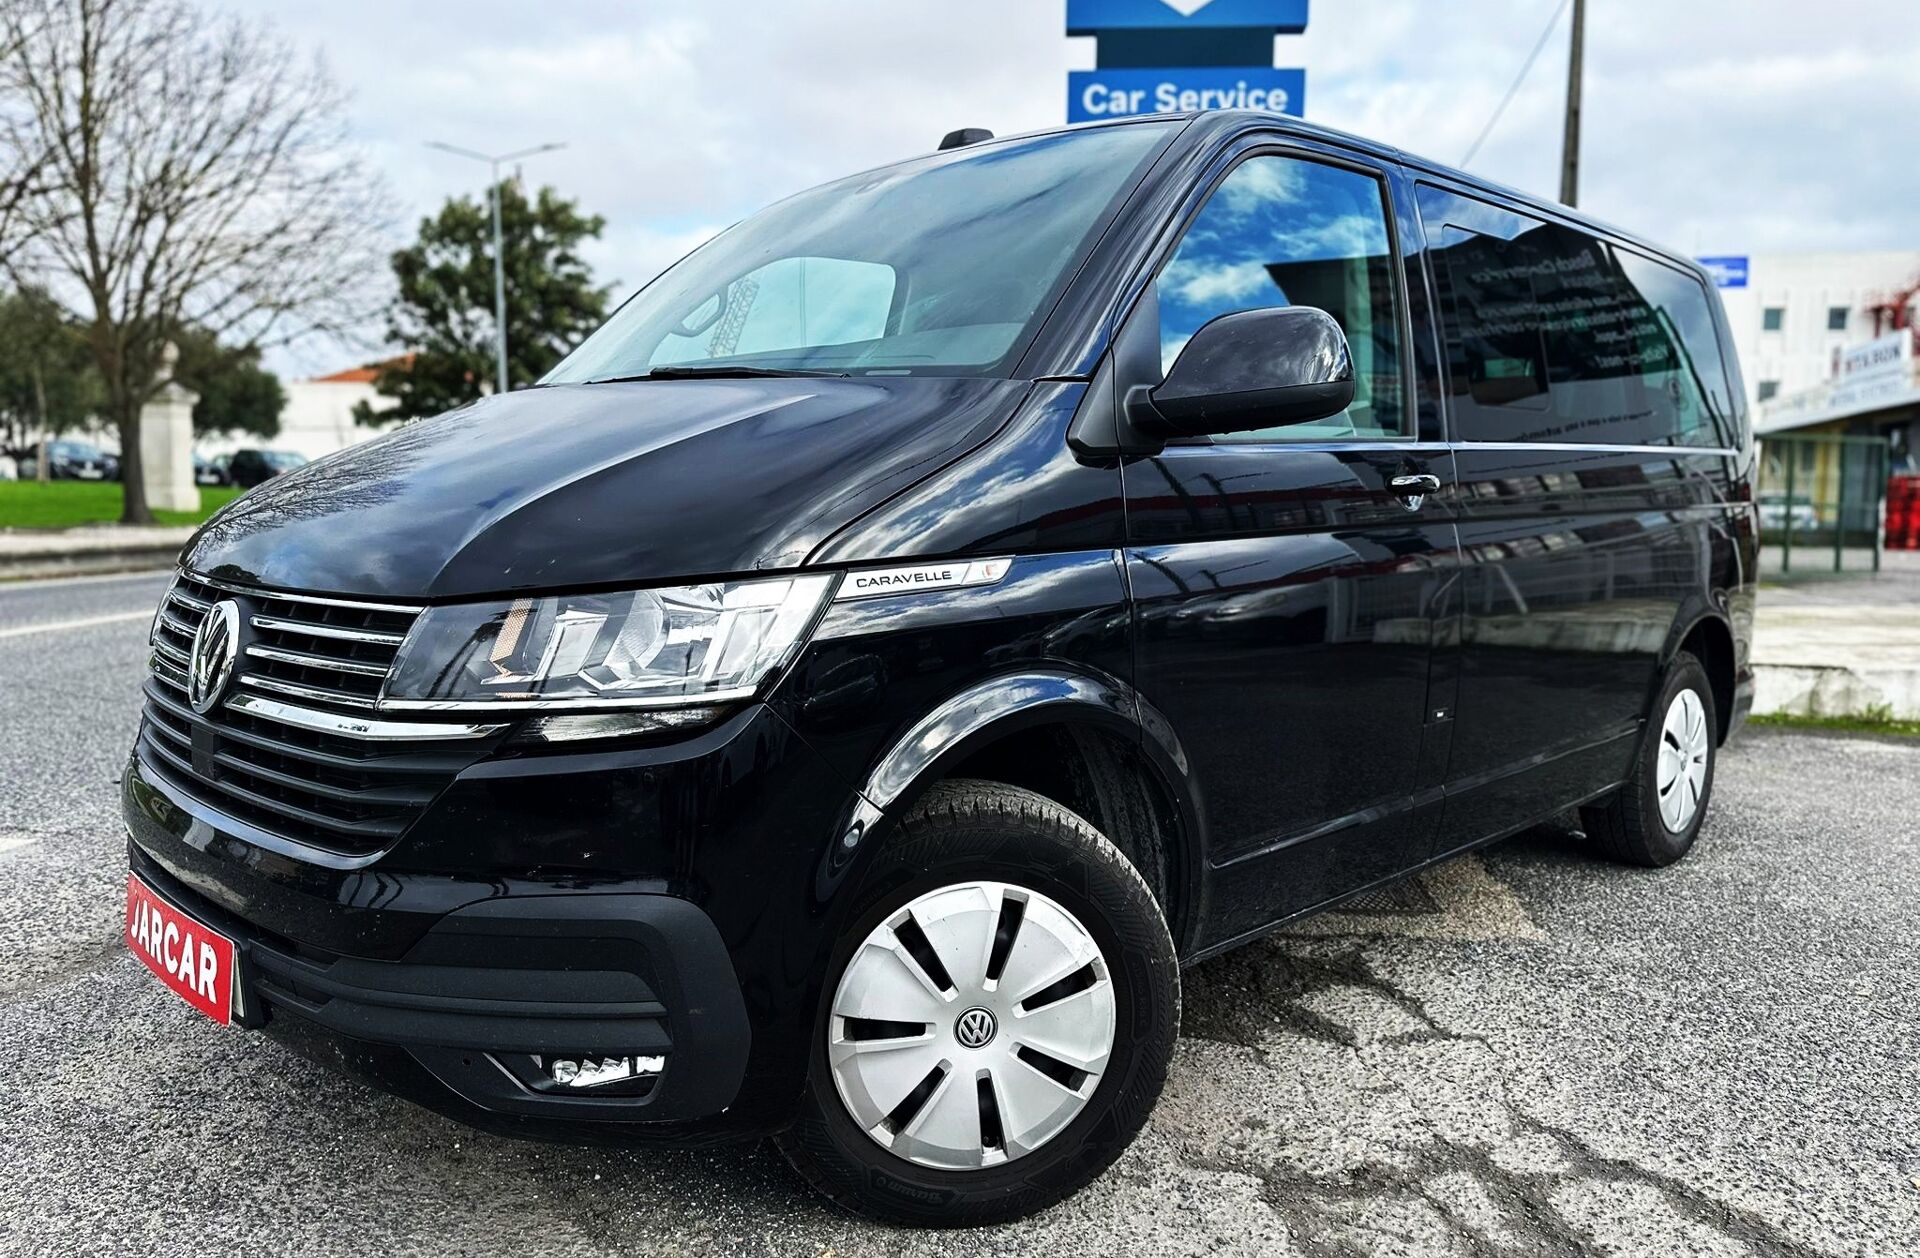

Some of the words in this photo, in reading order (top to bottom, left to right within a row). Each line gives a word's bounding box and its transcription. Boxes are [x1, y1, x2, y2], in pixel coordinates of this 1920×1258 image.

[1082, 83, 1146, 114] Car
[1155, 80, 1289, 112] Service
[856, 571, 952, 588] CARAVELLE
[130, 899, 218, 1004] JARCAR
